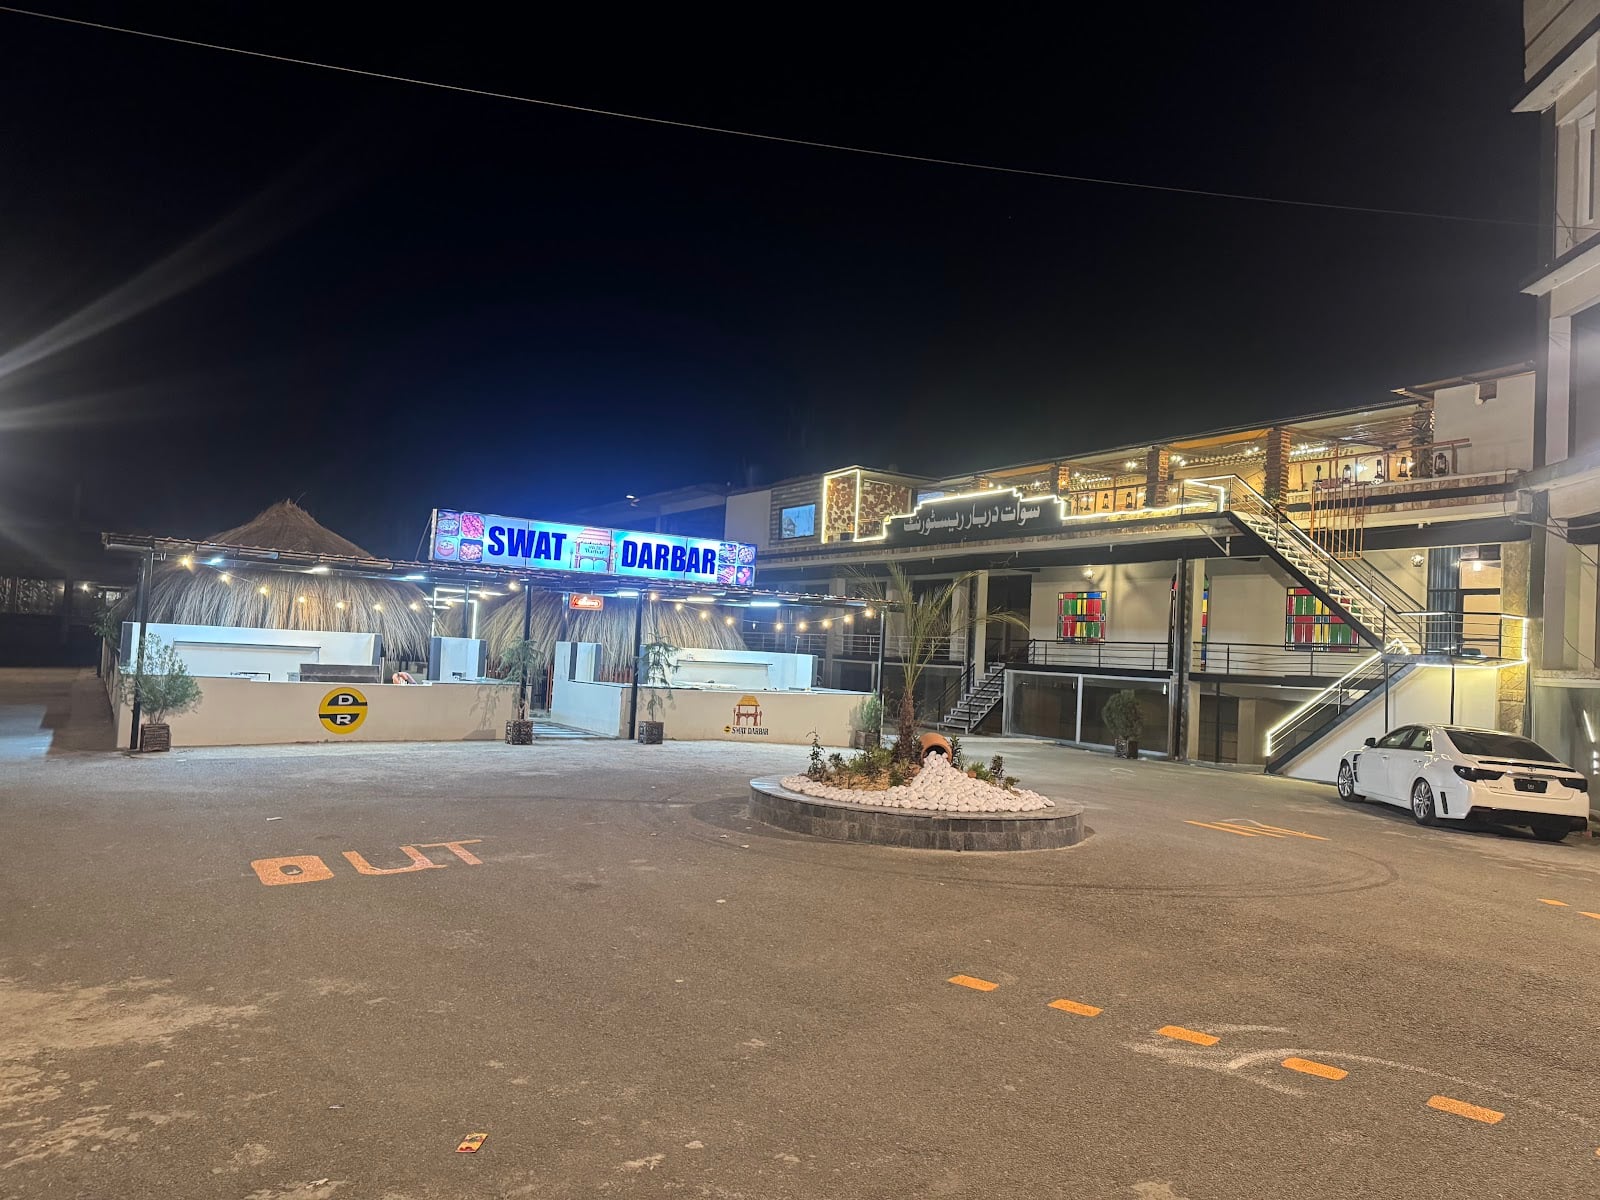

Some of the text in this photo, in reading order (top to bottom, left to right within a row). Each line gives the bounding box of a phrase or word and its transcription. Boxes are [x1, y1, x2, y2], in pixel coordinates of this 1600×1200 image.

[964, 503, 999, 530] دربار
[1000, 501, 1041, 526] سوات
[487, 525, 717, 575] SWAT DARBAR
[338, 694, 354, 706] D
[336, 714, 352, 725] R
[250, 839, 484, 887] OUT
